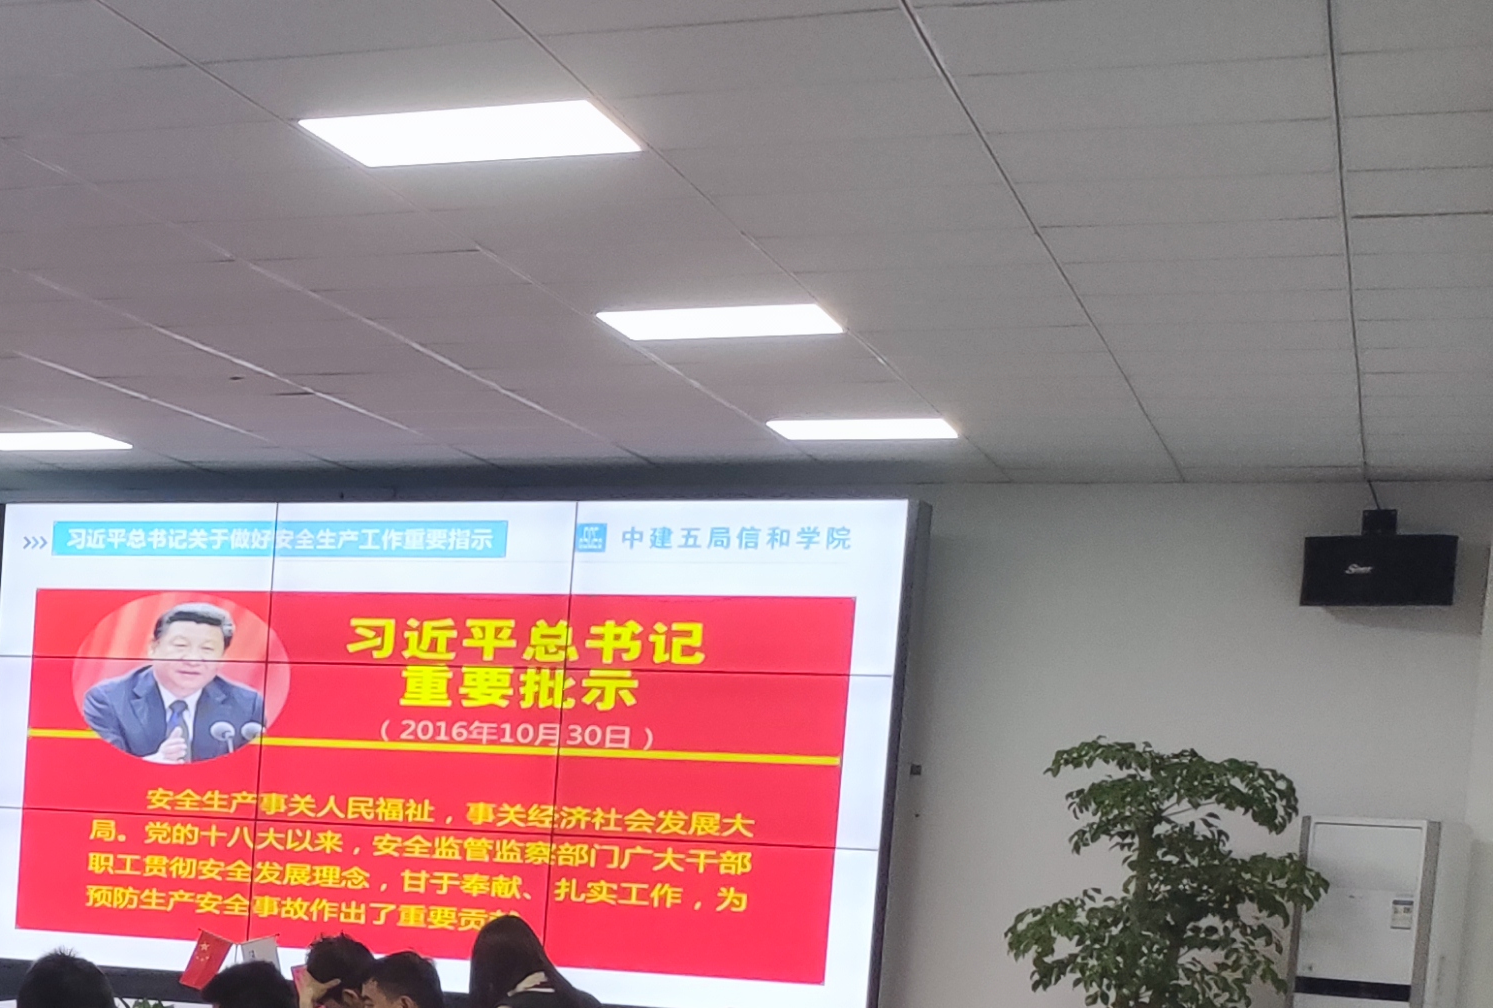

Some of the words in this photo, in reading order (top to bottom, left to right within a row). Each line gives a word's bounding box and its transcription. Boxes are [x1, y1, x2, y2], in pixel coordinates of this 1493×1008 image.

[66, 527, 494, 552] 习近平总书记关于做好安全生产工作重要指示
[621, 525, 852, 551] 中建五局信和学院
[346, 617, 706, 665] 习近平总书记
[399, 664, 639, 711] 重要批示
[146, 787, 756, 838] 安全生产事关人民福祉，事关经济社会发展大
[89, 819, 753, 876] 局。党的十八大以来，安全监管监察部门广大干部
[87, 852, 748, 913] 职工贯彻安全发展理念，甘于奉献、扎实工作，为
[85, 884, 519, 932] 预防生产安全事故作出了重要贡
